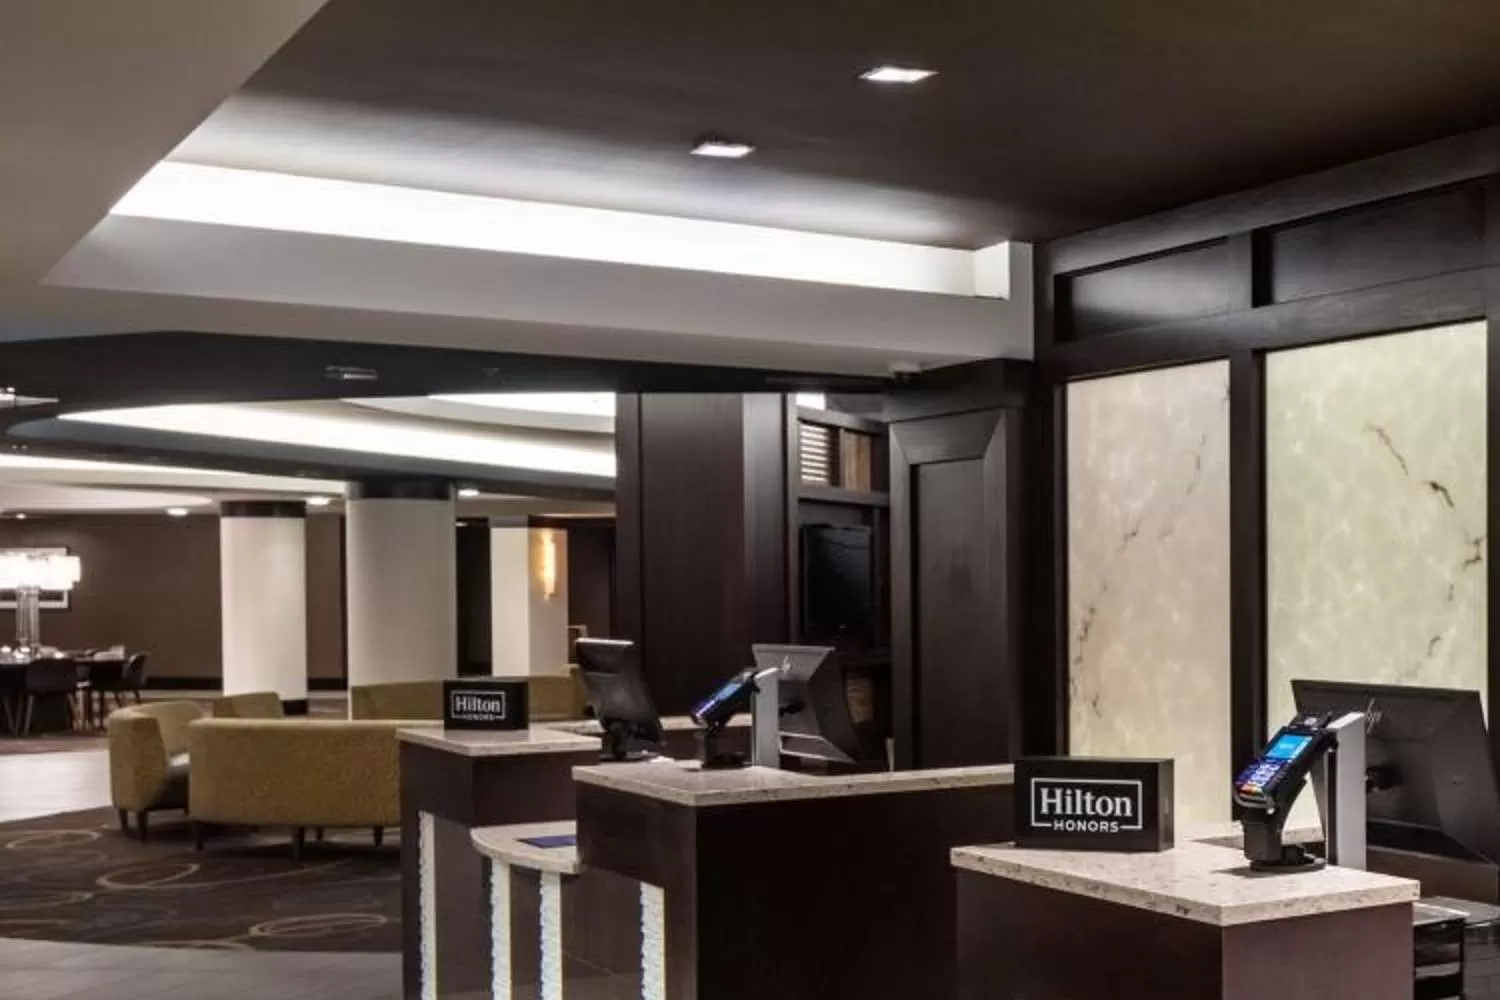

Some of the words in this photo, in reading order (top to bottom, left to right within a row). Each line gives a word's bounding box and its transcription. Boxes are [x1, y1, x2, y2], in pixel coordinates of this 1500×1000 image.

[456, 696, 501, 713] Hilton
[1040, 787, 1133, 817] Hilton
[1053, 820, 1120, 833] HONORS
